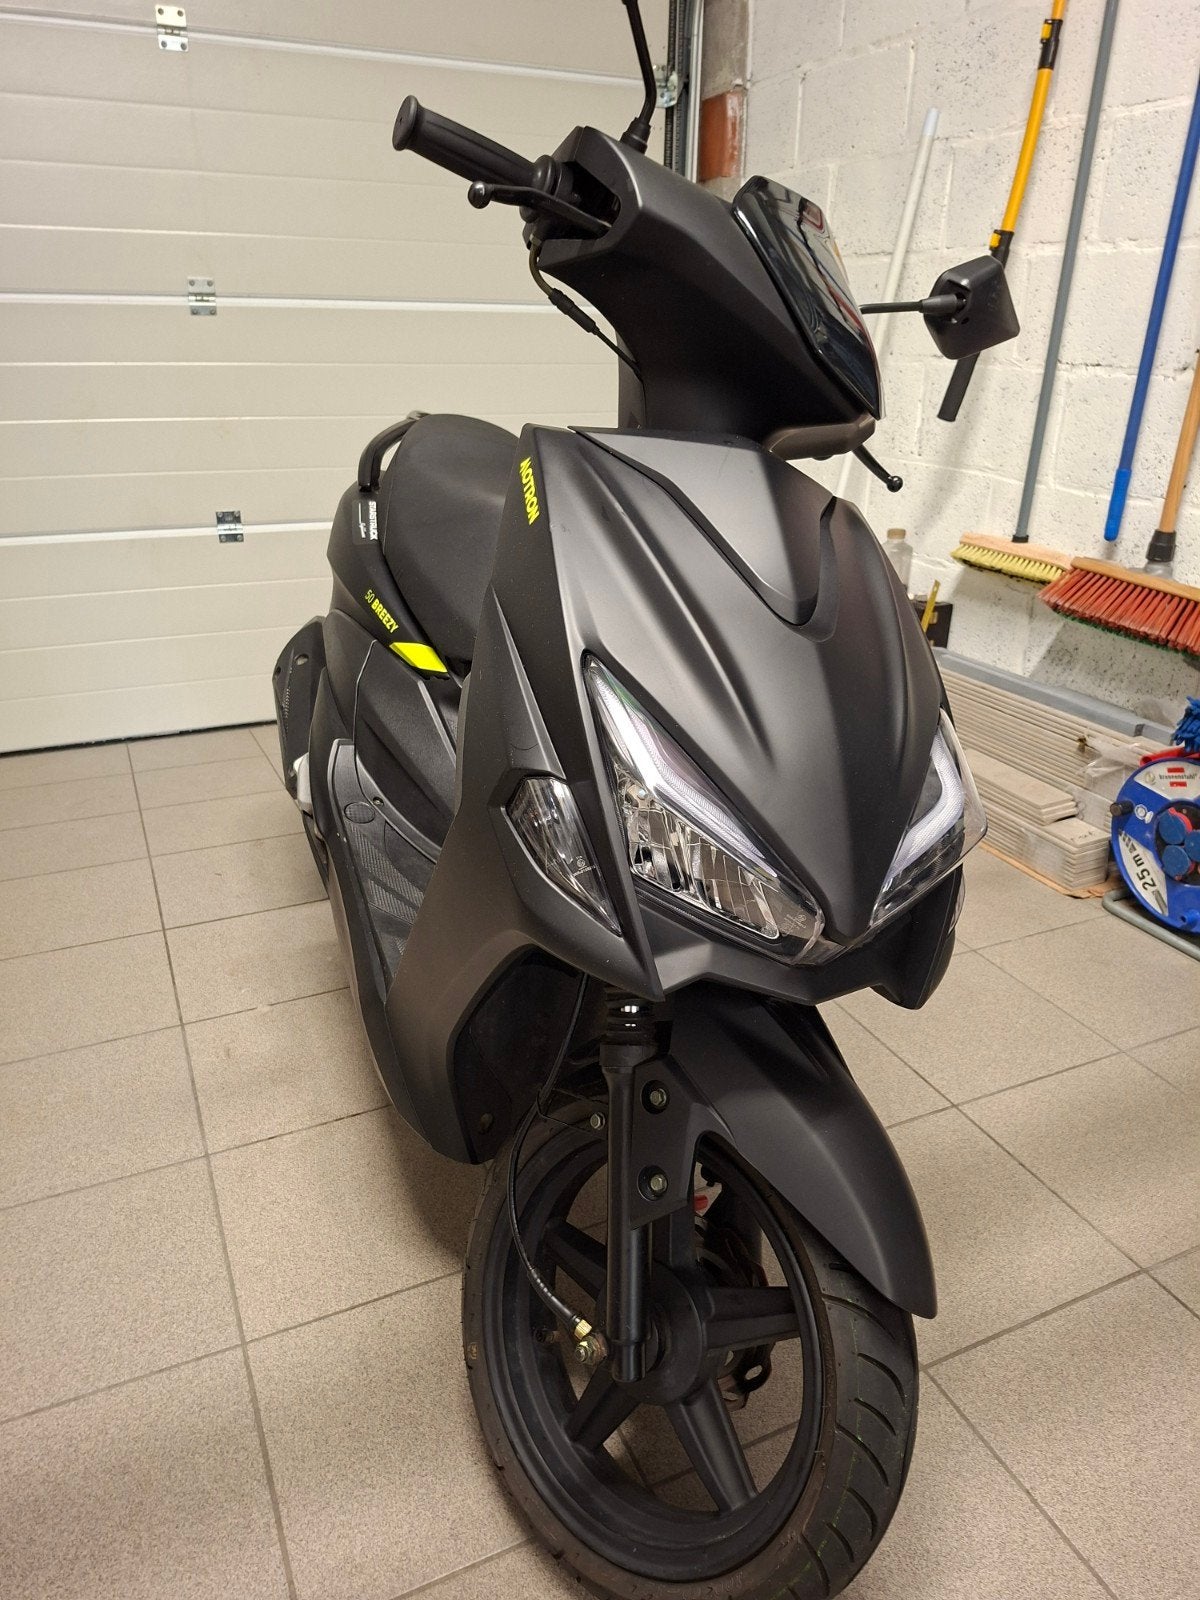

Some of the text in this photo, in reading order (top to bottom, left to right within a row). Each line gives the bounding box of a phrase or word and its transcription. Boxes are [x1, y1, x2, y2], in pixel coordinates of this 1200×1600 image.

[519, 456, 540, 526] MOTRON
[364, 589, 399, 634] 50 BREEZY
[1136, 868, 1157, 891] 25
